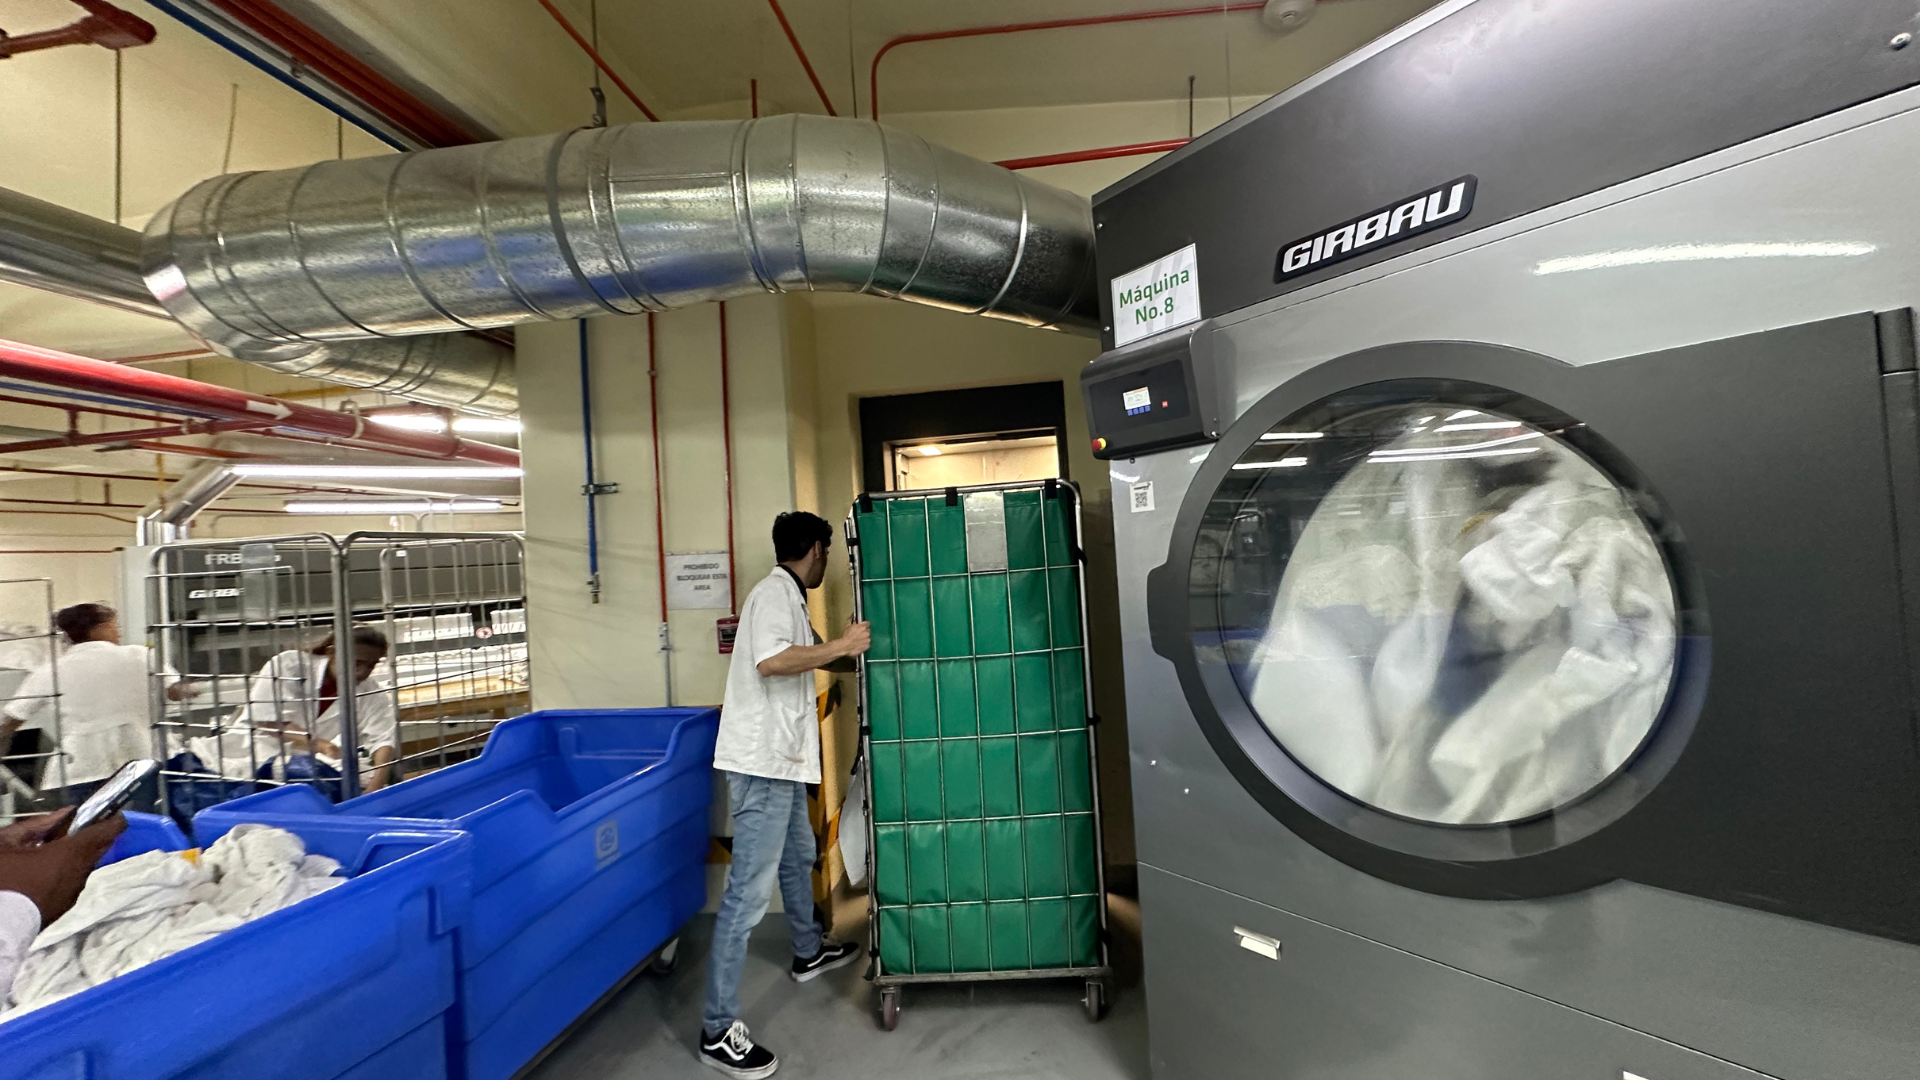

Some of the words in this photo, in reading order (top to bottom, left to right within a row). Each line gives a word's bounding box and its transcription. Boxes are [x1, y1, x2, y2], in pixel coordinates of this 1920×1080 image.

[1282, 181, 1466, 274] GIRBAU
[1119, 269, 1190, 308] Máquina
[1135, 296, 1174, 325] No.8
